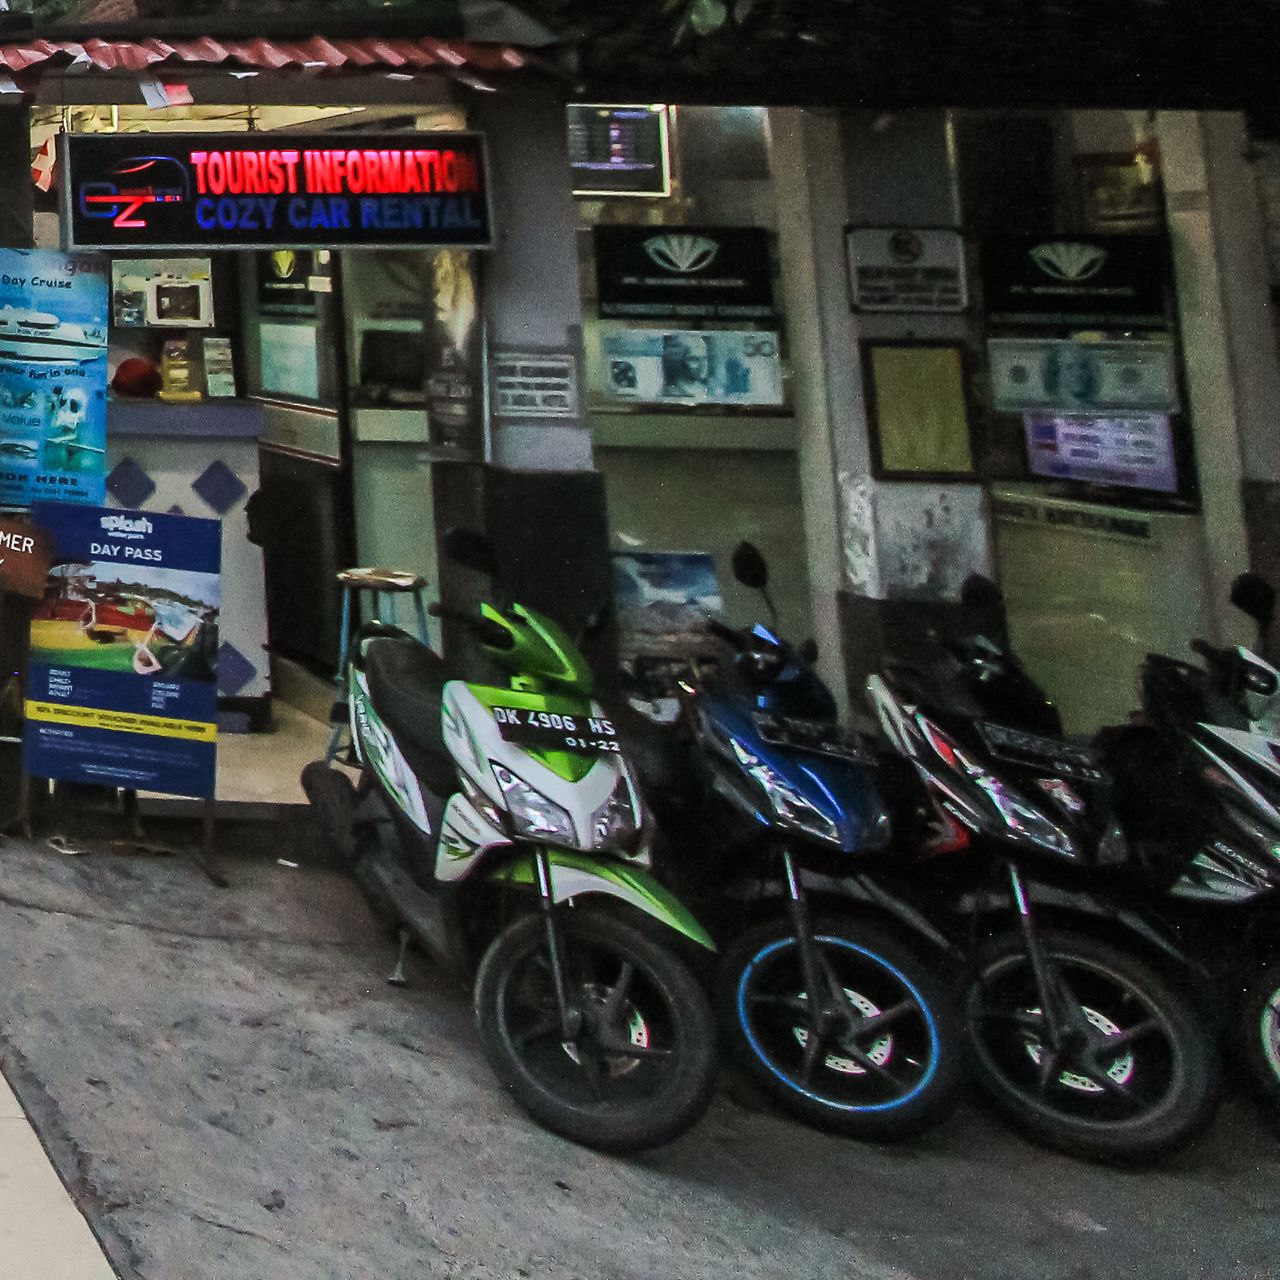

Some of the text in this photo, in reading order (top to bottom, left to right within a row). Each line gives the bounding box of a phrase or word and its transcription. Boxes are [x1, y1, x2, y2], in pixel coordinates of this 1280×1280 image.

[191, 150, 301, 195] TOURIST
[195, 196, 482, 230] COZY CAR RENTAL
[1, 274, 72, 288] Day Cruise
[90, 542, 163, 562] DAY PASS
[493, 706, 522, 725] DK
